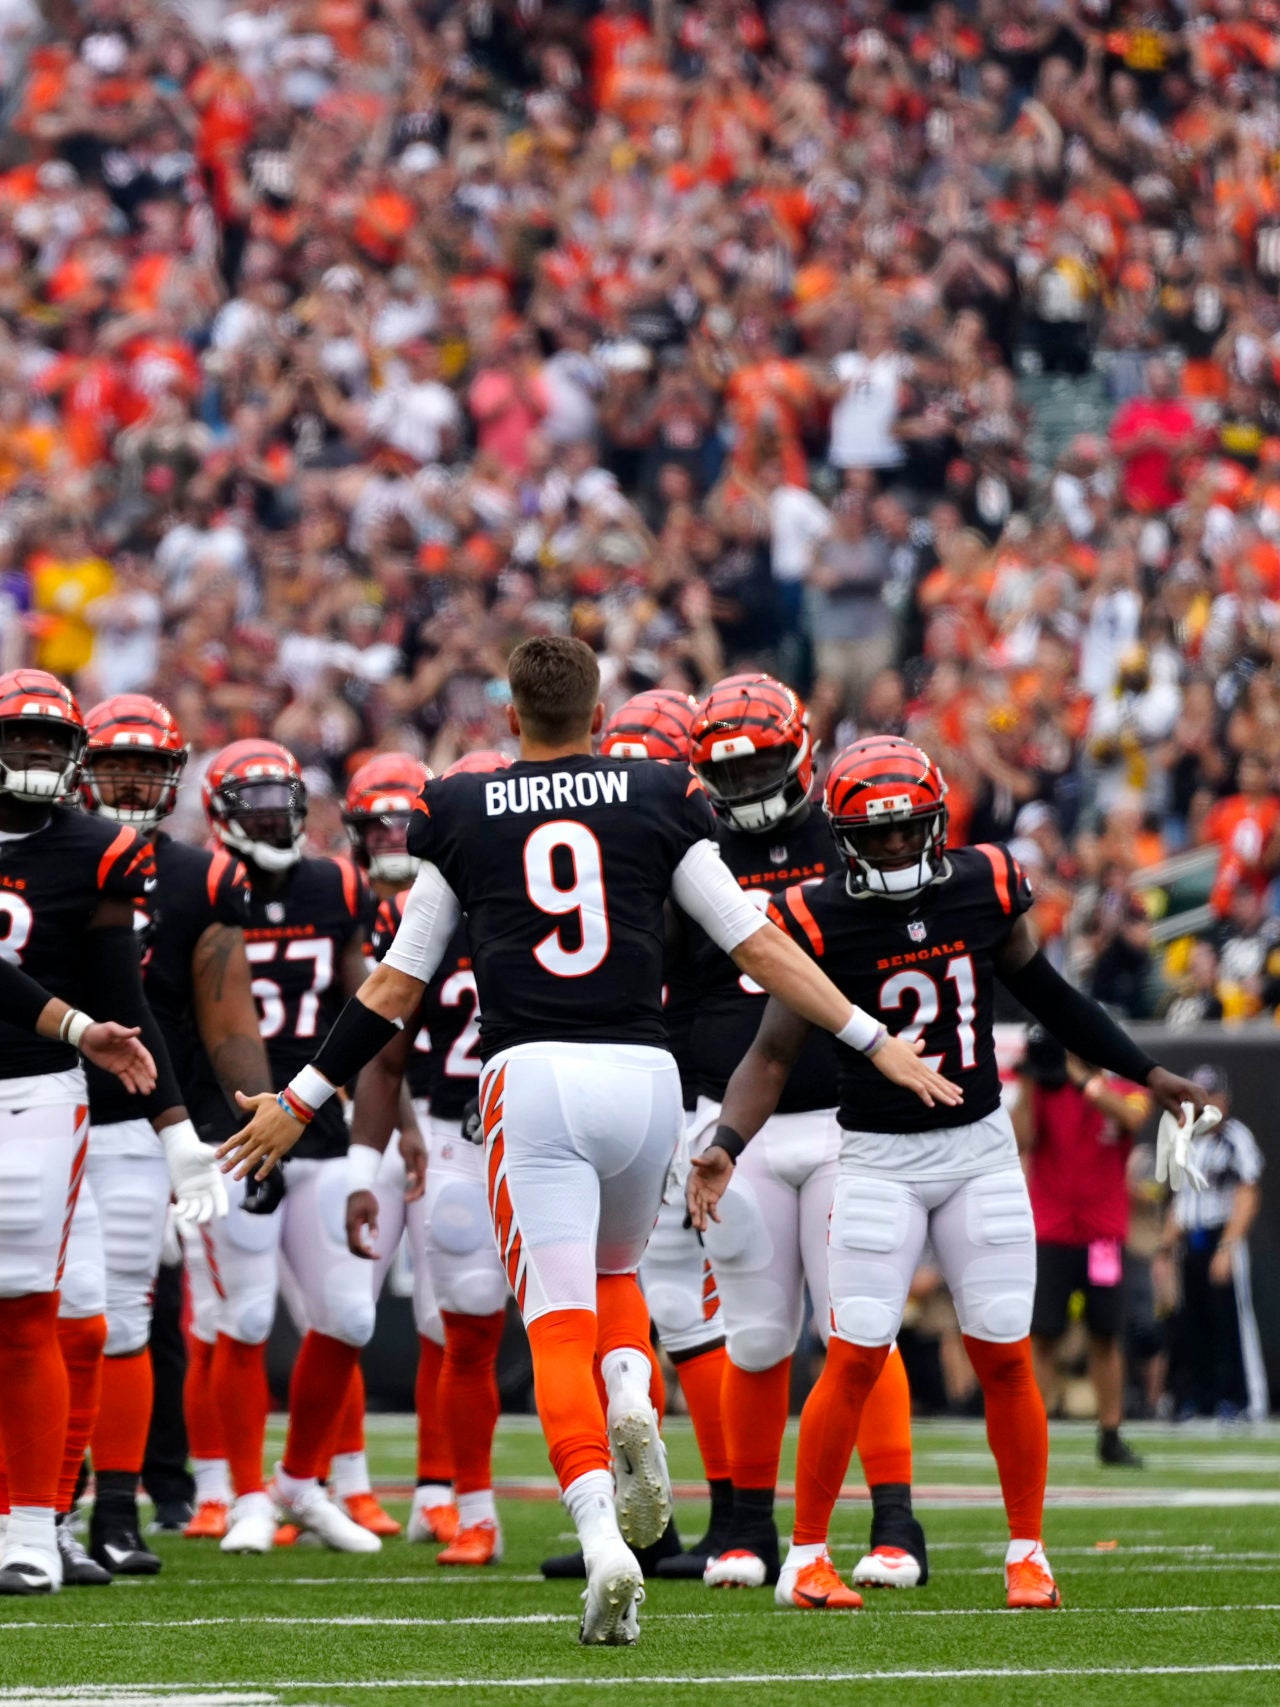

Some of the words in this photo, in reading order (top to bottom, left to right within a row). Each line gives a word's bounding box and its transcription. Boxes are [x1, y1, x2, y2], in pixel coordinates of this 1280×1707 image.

[485, 770, 629, 816] BURROW
[522, 819, 611, 978] 9
[738, 862, 825, 886] BENGALS
[244, 937, 334, 1039] 57
[876, 940, 966, 970] BENGALS
[439, 969, 483, 1077] 2
[878, 953, 978, 1074] 21
